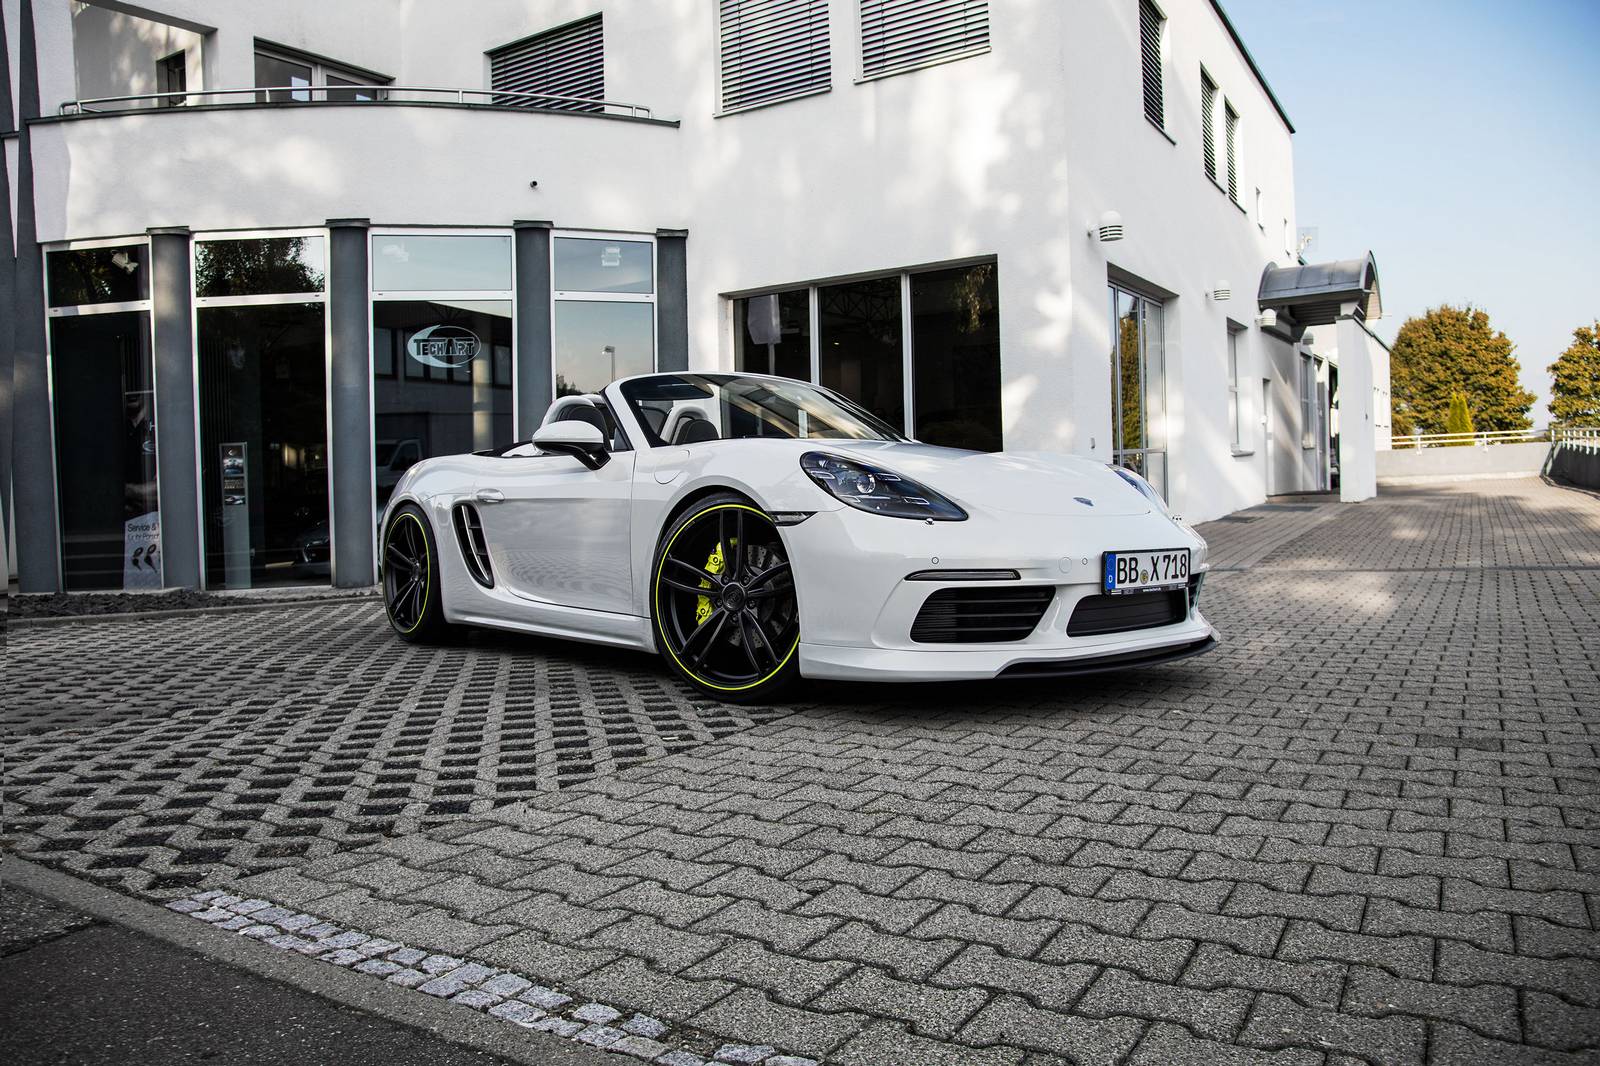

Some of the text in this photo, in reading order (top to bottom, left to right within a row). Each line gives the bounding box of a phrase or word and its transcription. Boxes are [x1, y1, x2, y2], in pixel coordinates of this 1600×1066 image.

[413, 337, 475, 356] TECHART
[1117, 554, 1187, 584] BB X 718
[1108, 575, 1113, 583] D
